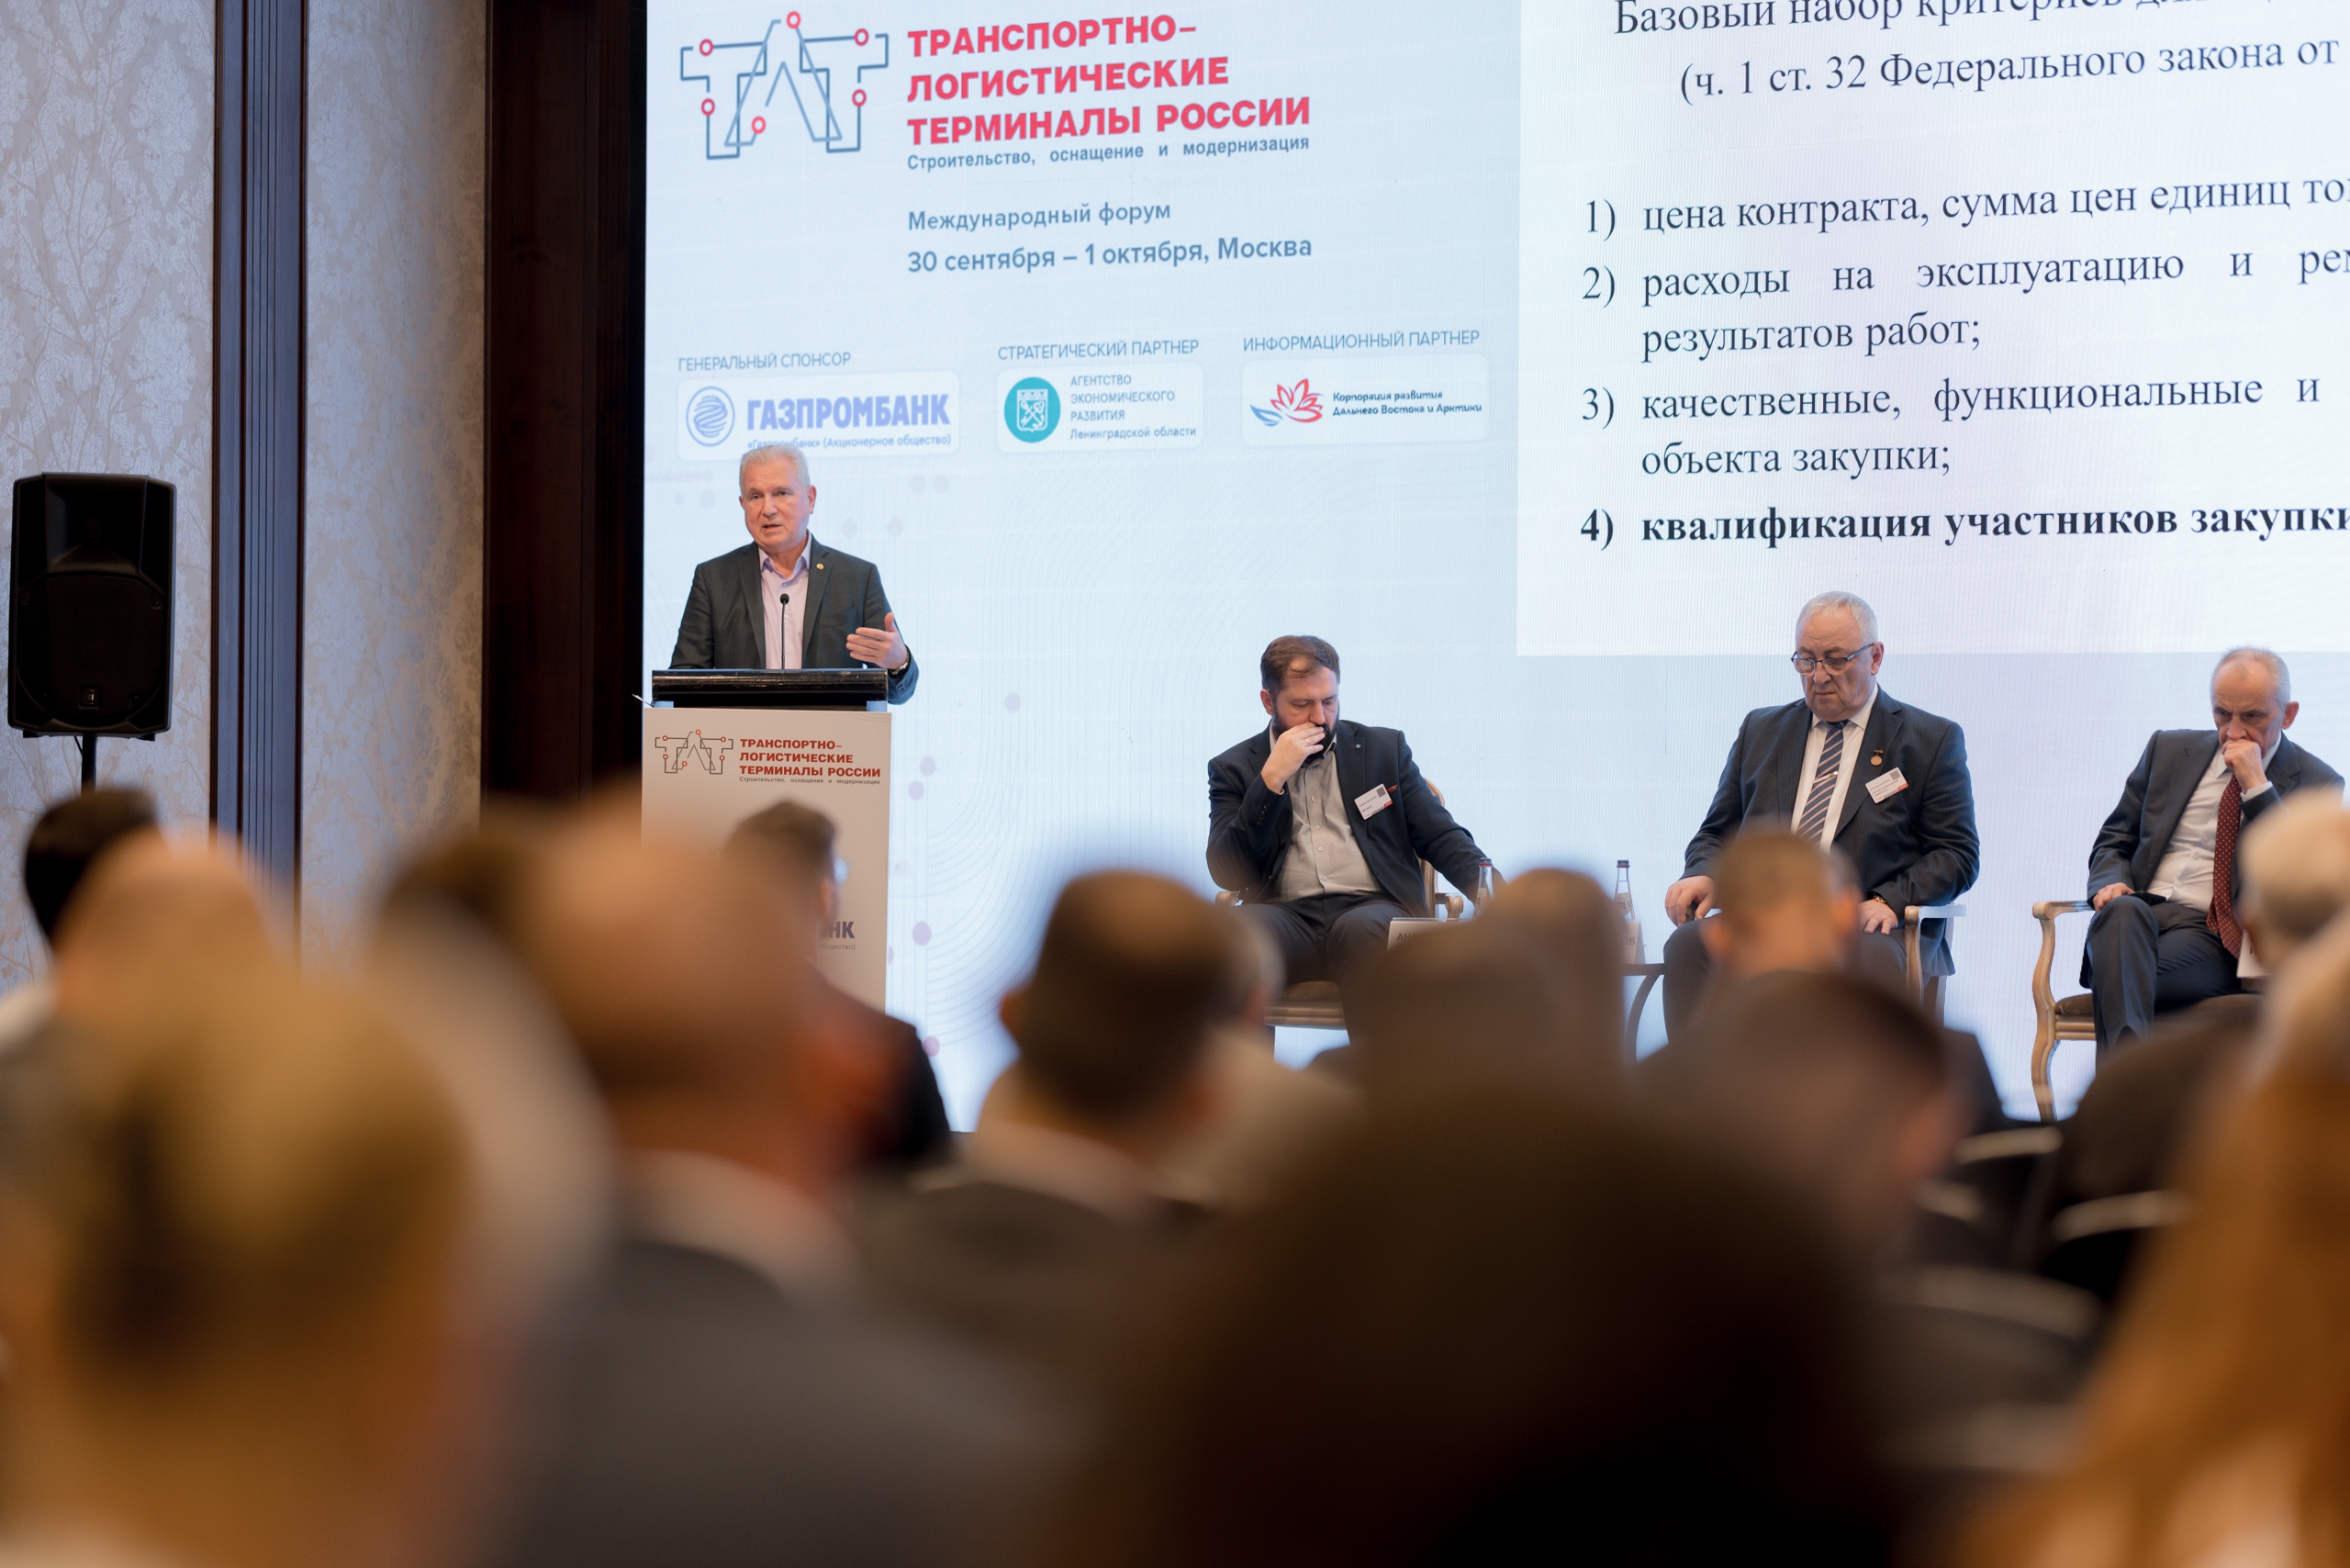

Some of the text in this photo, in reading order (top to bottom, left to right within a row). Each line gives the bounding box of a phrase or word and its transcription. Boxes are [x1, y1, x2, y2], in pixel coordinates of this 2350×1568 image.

[908, 56, 1229, 103] ЛОГИСТИЧЕСКИЕ
[1680, 39, 2340, 106] (ч. 1 ст. 32 Федерального закона от
[907, 96, 1310, 146] ТЕРМИНАЛЫ РОССИИ
[907, 137, 1310, 174] Строительство, оснащение и модернизация
[908, 201, 1170, 232] Международный форум
[1586, 178, 2350, 241] 1) цена контракта, сумма цен единиц то
[908, 250, 938, 274] 30
[945, 246, 1056, 274] сентября
[1084, 242, 1094, 265] 1
[1102, 240, 1210, 268] октября,
[1217, 236, 1312, 260] Москва
[1582, 249, 2350, 307] 2) расходы на эксплуатацию и ре
[997, 339, 1200, 361] СТРАТЕГИЧЕСКИЙ ПАРТНЕР
[1243, 329, 1481, 353] ИНФОРМАЦИОННЫЙ ПАРТНЕР
[1640, 309, 1980, 364] результатов работ;
[677, 351, 852, 372] ГЕНЕРАЛЬНЫЙ СПОНСОР
[1069, 374, 1133, 386] АГЕНТСТВО
[746, 393, 951, 431] ГАЗПРОМБАНК
[1070, 389, 1176, 405] ЭКОНОМИЧЕСКОГО
[1332, 389, 1443, 405] Корпорация развития
[1332, 406, 1380, 417] Дальнего
[1381, 404, 1426, 415] Востока
[1435, 403, 1483, 415] Арктики
[1581, 376, 2320, 429] 3) качественные, функциональные и
[1070, 409, 1125, 422] РАЗВИТИЯ
[822, 436, 895, 449] (Акционерное
[896, 433, 952, 447] общество)
[1069, 425, 1197, 441] Ленинградской области
[1640, 440, 1951, 481] объекта закупки;
[1579, 508, 1615, 551] 4)
[1641, 505, 1931, 550] квалификация
[1943, 510, 2178, 547] участников
[740, 753, 853, 763] ЛОГИСТИЧЕСКИЕ
[740, 766, 880, 778] ТЕРМИНАЛЫ РОССИИ
